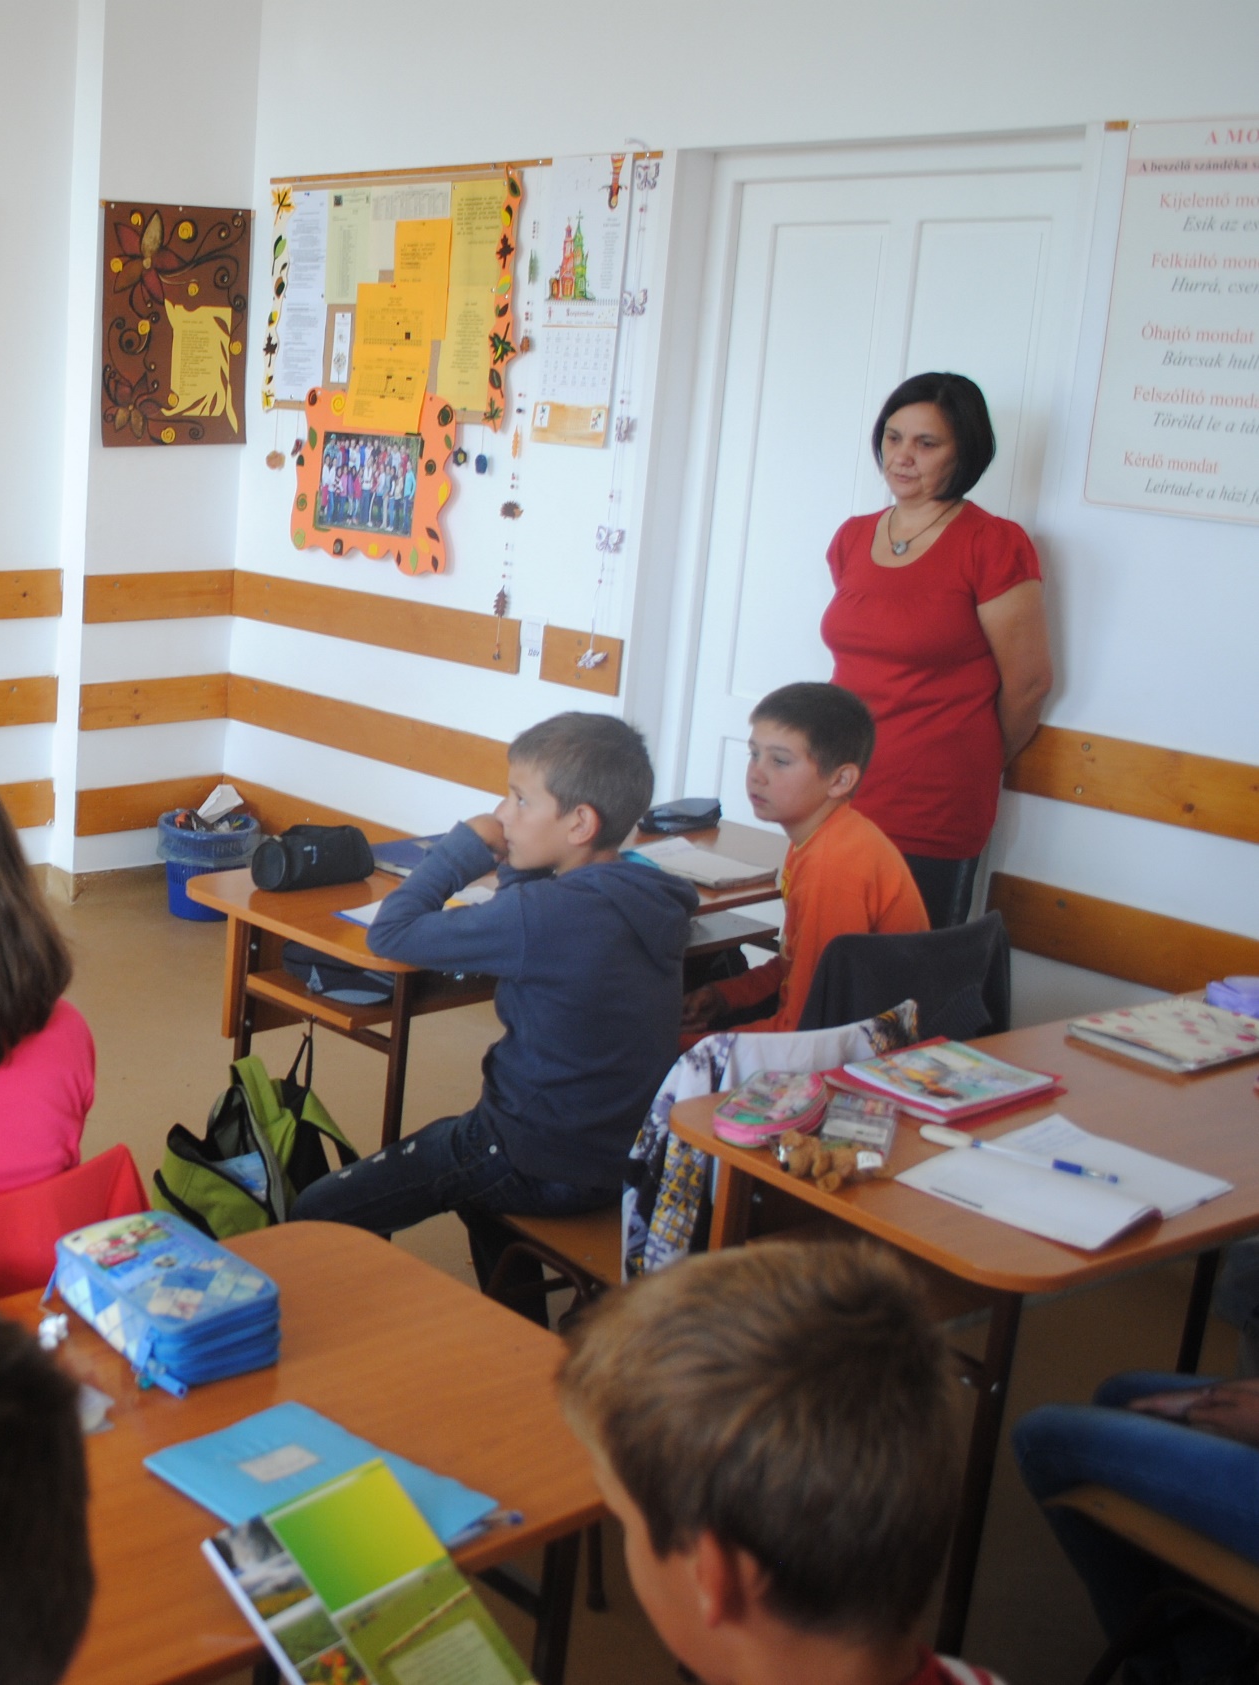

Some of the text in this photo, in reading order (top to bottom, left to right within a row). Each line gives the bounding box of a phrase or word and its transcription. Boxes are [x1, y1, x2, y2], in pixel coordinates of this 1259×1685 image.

[1205, 130, 1218, 145] A
[1139, 162, 1147, 172] A
[1194, 158, 1248, 172] szándéka
[1160, 192, 1230, 213] Kijelentő
[1183, 215, 1215, 232] Esik
[1220, 220, 1239, 232] az
[1151, 252, 1259, 270] Felkiáltó mon
[1141, 320, 1255, 345] Óhajtó mondat
[1161, 350, 1259, 370] Bárcsak hull
[1132, 384, 1205, 406] Felszólító
[1152, 411, 1204, 431] Töröld
[1206, 415, 1221, 432] le
[1225, 420, 1235, 433] a
[1123, 451, 1219, 475] Kérdő mondat
[1144, 478, 1204, 499] Leírtad-e
[1207, 487, 1217, 500] a
[1219, 486, 1247, 503] házi
